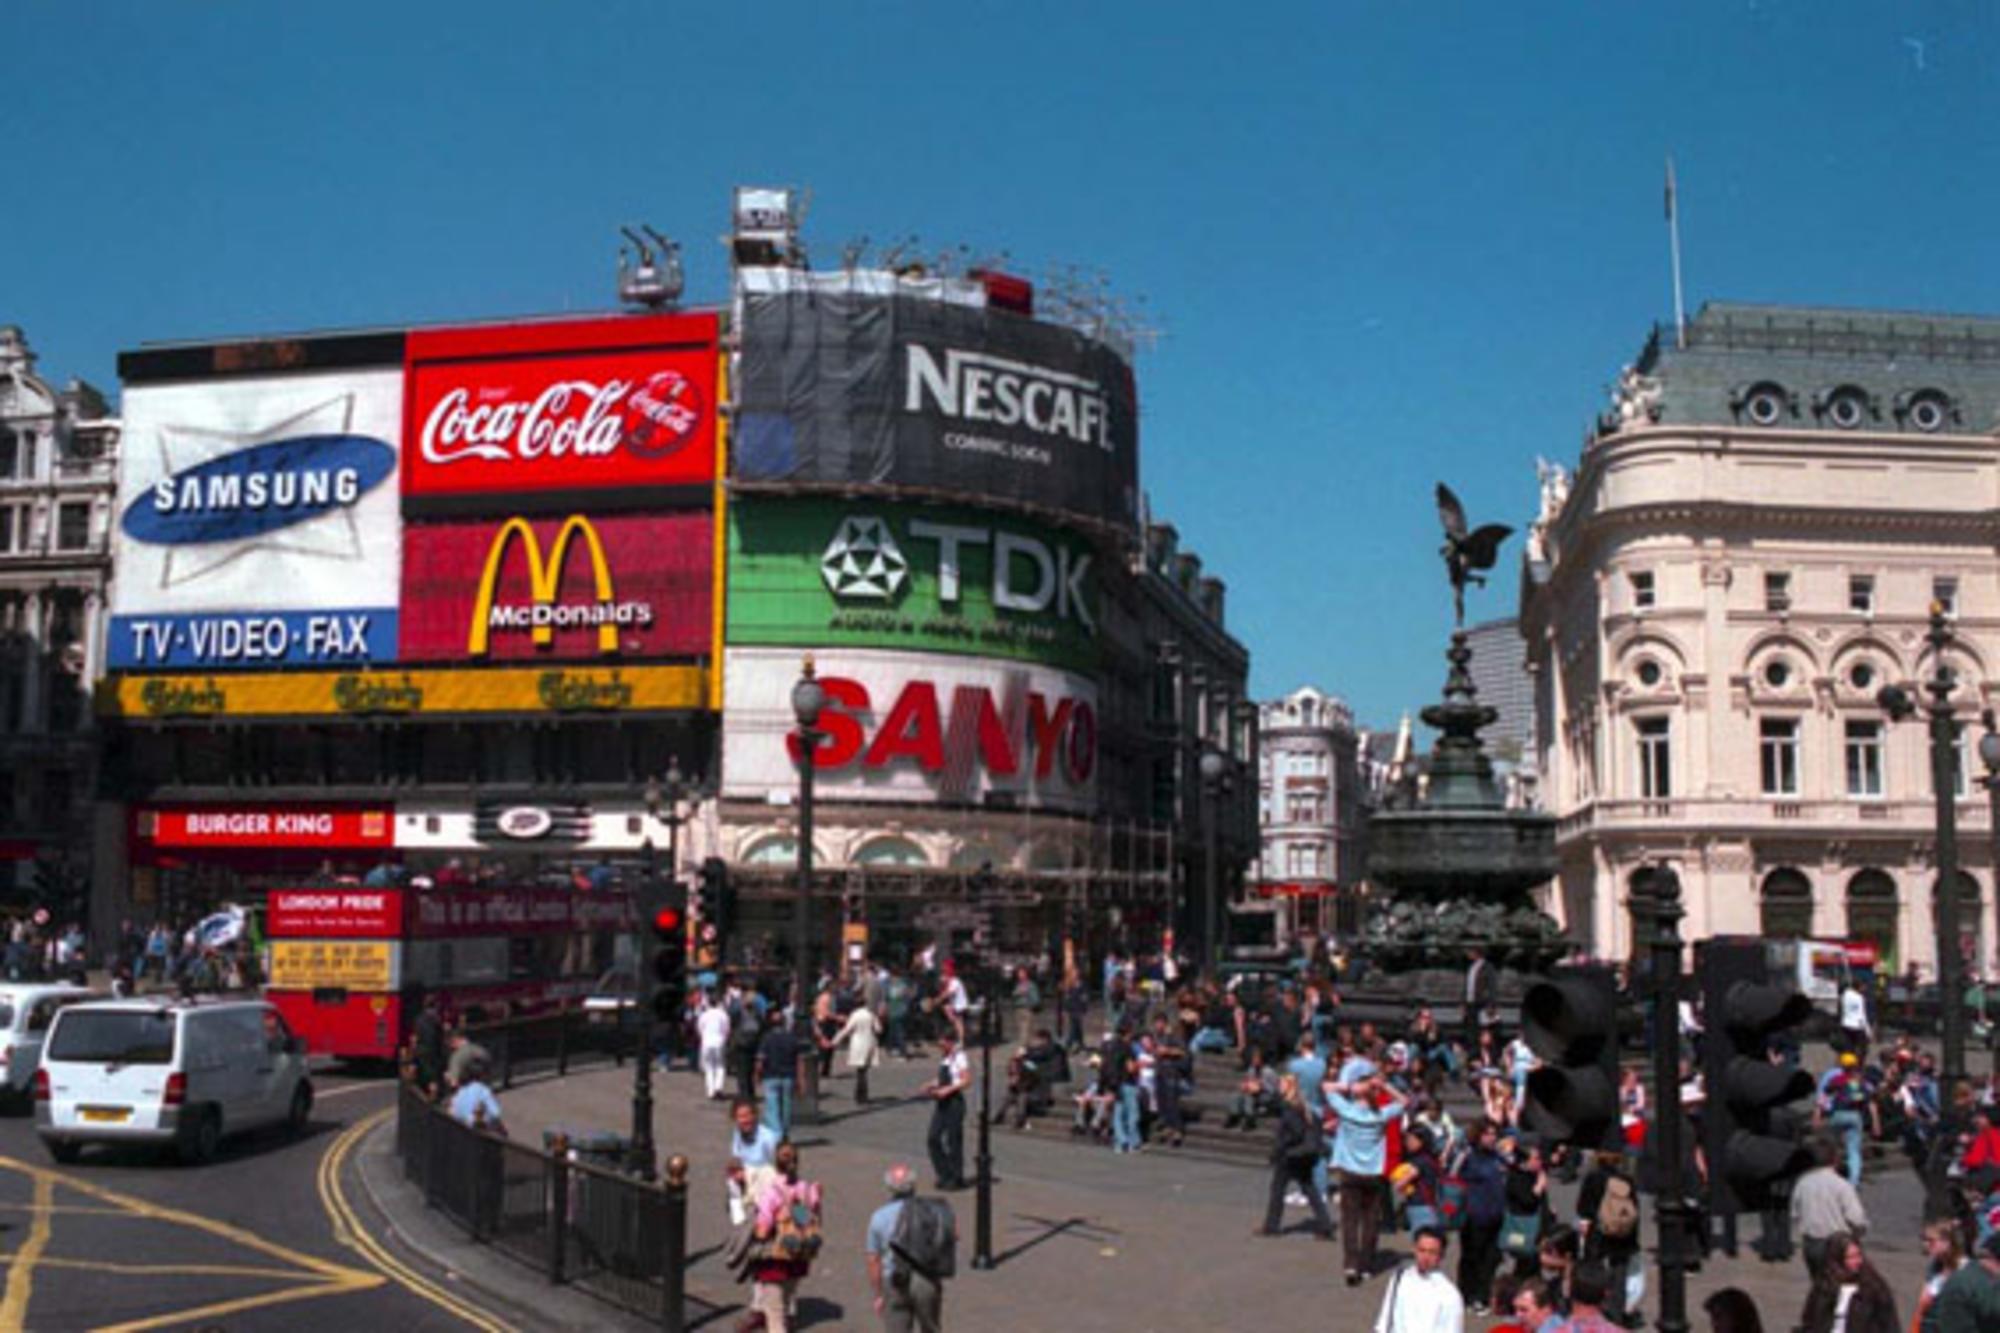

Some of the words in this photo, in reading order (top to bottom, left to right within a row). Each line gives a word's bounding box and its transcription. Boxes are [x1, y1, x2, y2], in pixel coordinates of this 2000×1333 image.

[420, 379, 632, 463] Coca-Cola
[154, 468, 358, 510] SAMSUNG
[909, 518, 1095, 632] TDK
[306, 615, 368, 654] FAX
[489, 602, 652, 627] McDonald's
[786, 676, 1095, 783] SANYO
[186, 814, 270, 834] BURGER
[275, 813, 333, 833] KING
[343, 895, 382, 911] PRIDE
